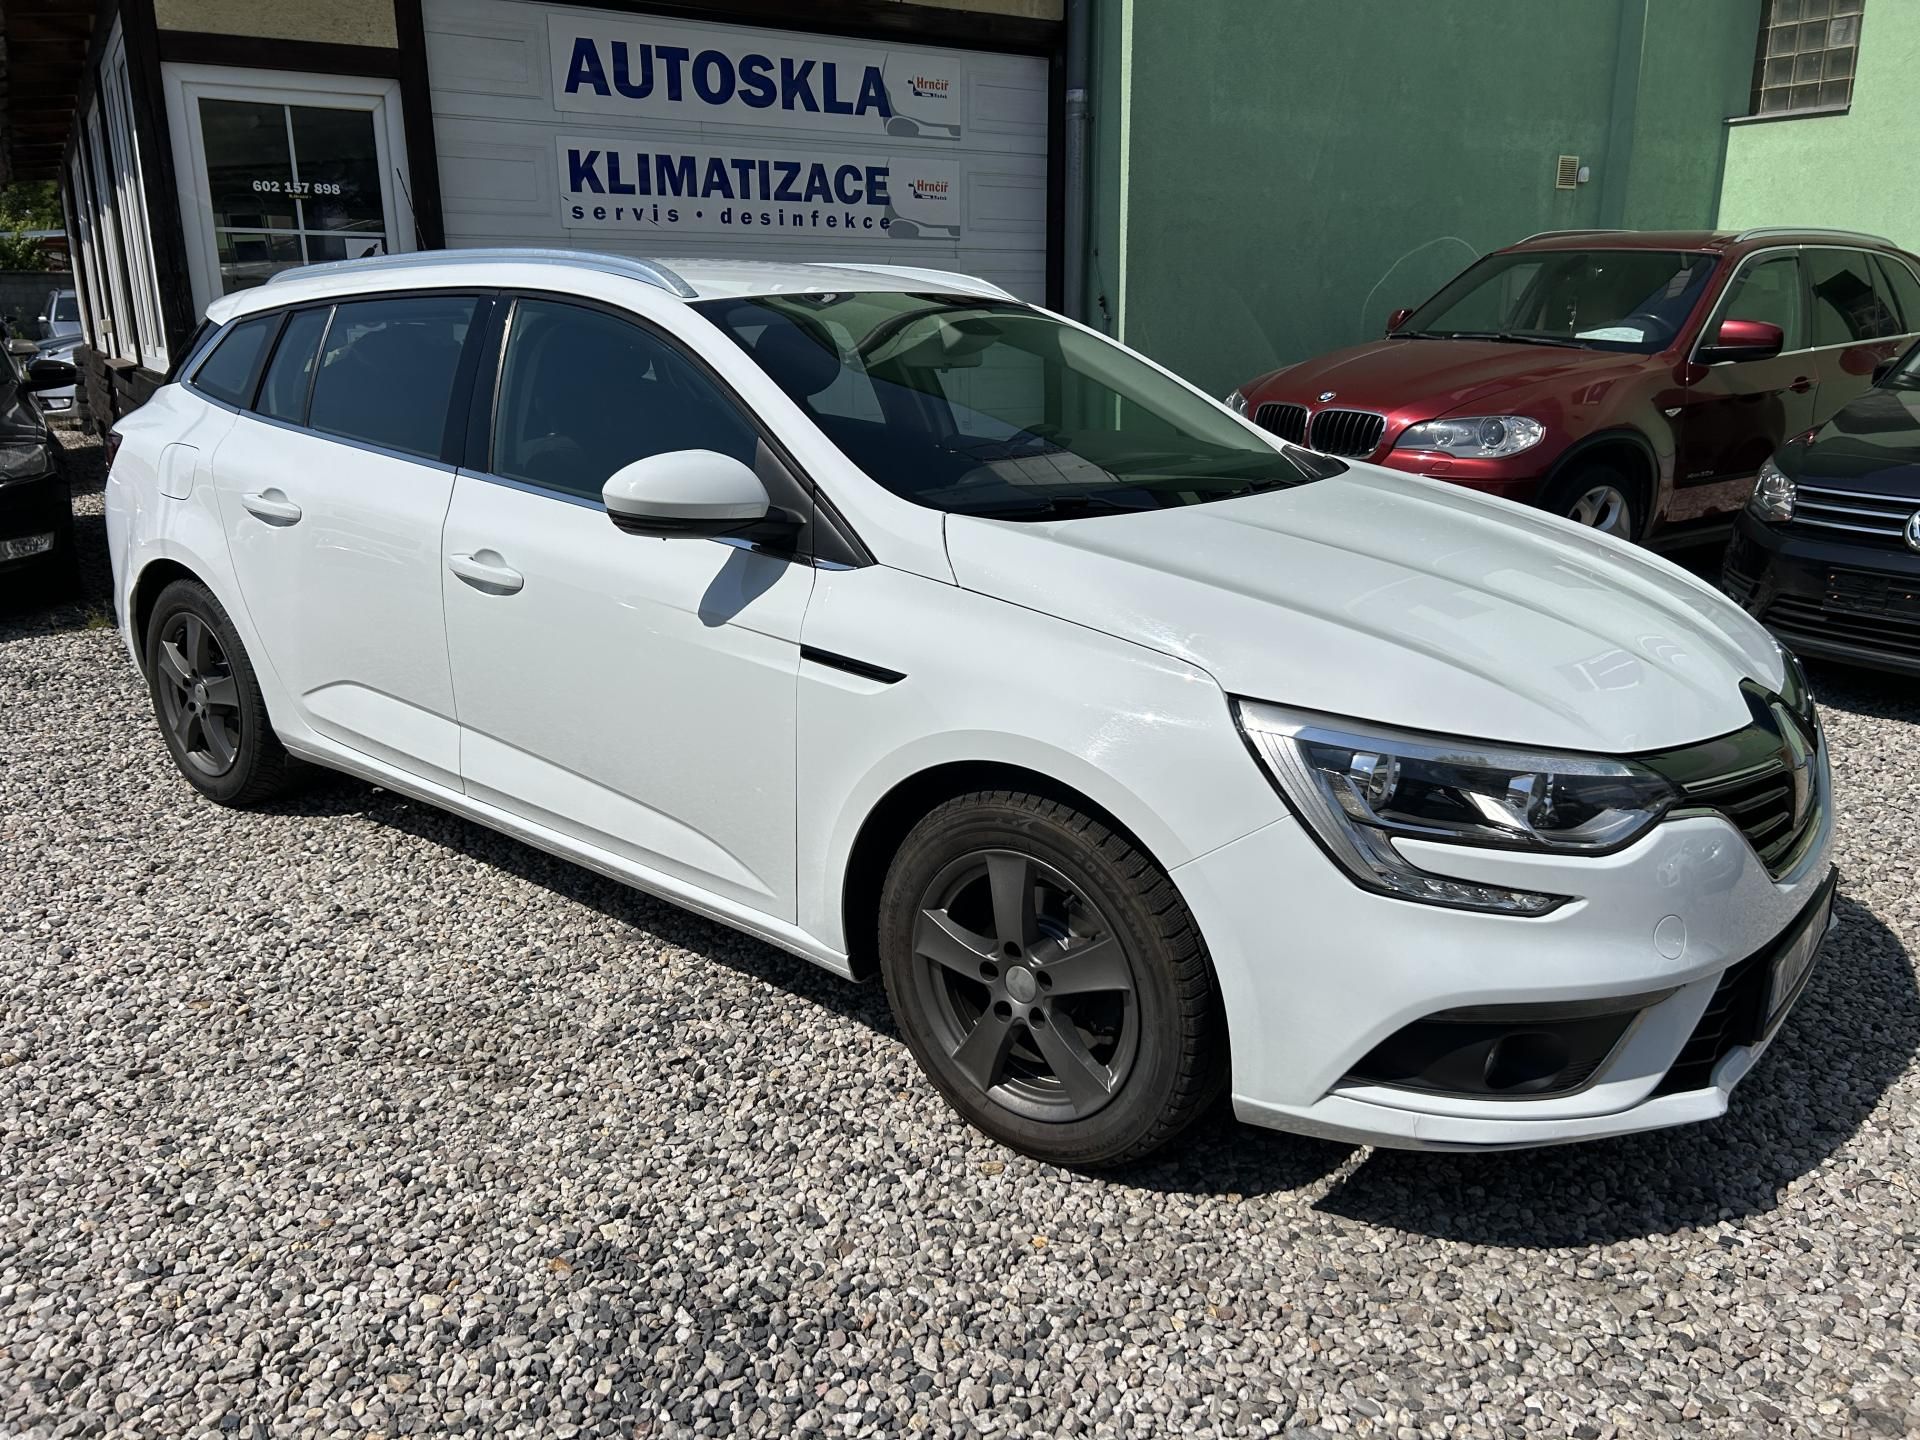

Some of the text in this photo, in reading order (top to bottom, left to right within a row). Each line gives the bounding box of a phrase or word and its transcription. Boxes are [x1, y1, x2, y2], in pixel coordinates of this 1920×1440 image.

[565, 37, 892, 118] AUTOSKLA
[252, 180, 341, 195] 602 157 898
[568, 149, 890, 206] KLIMATIZACE
[571, 204, 891, 230] servis desinfekce
